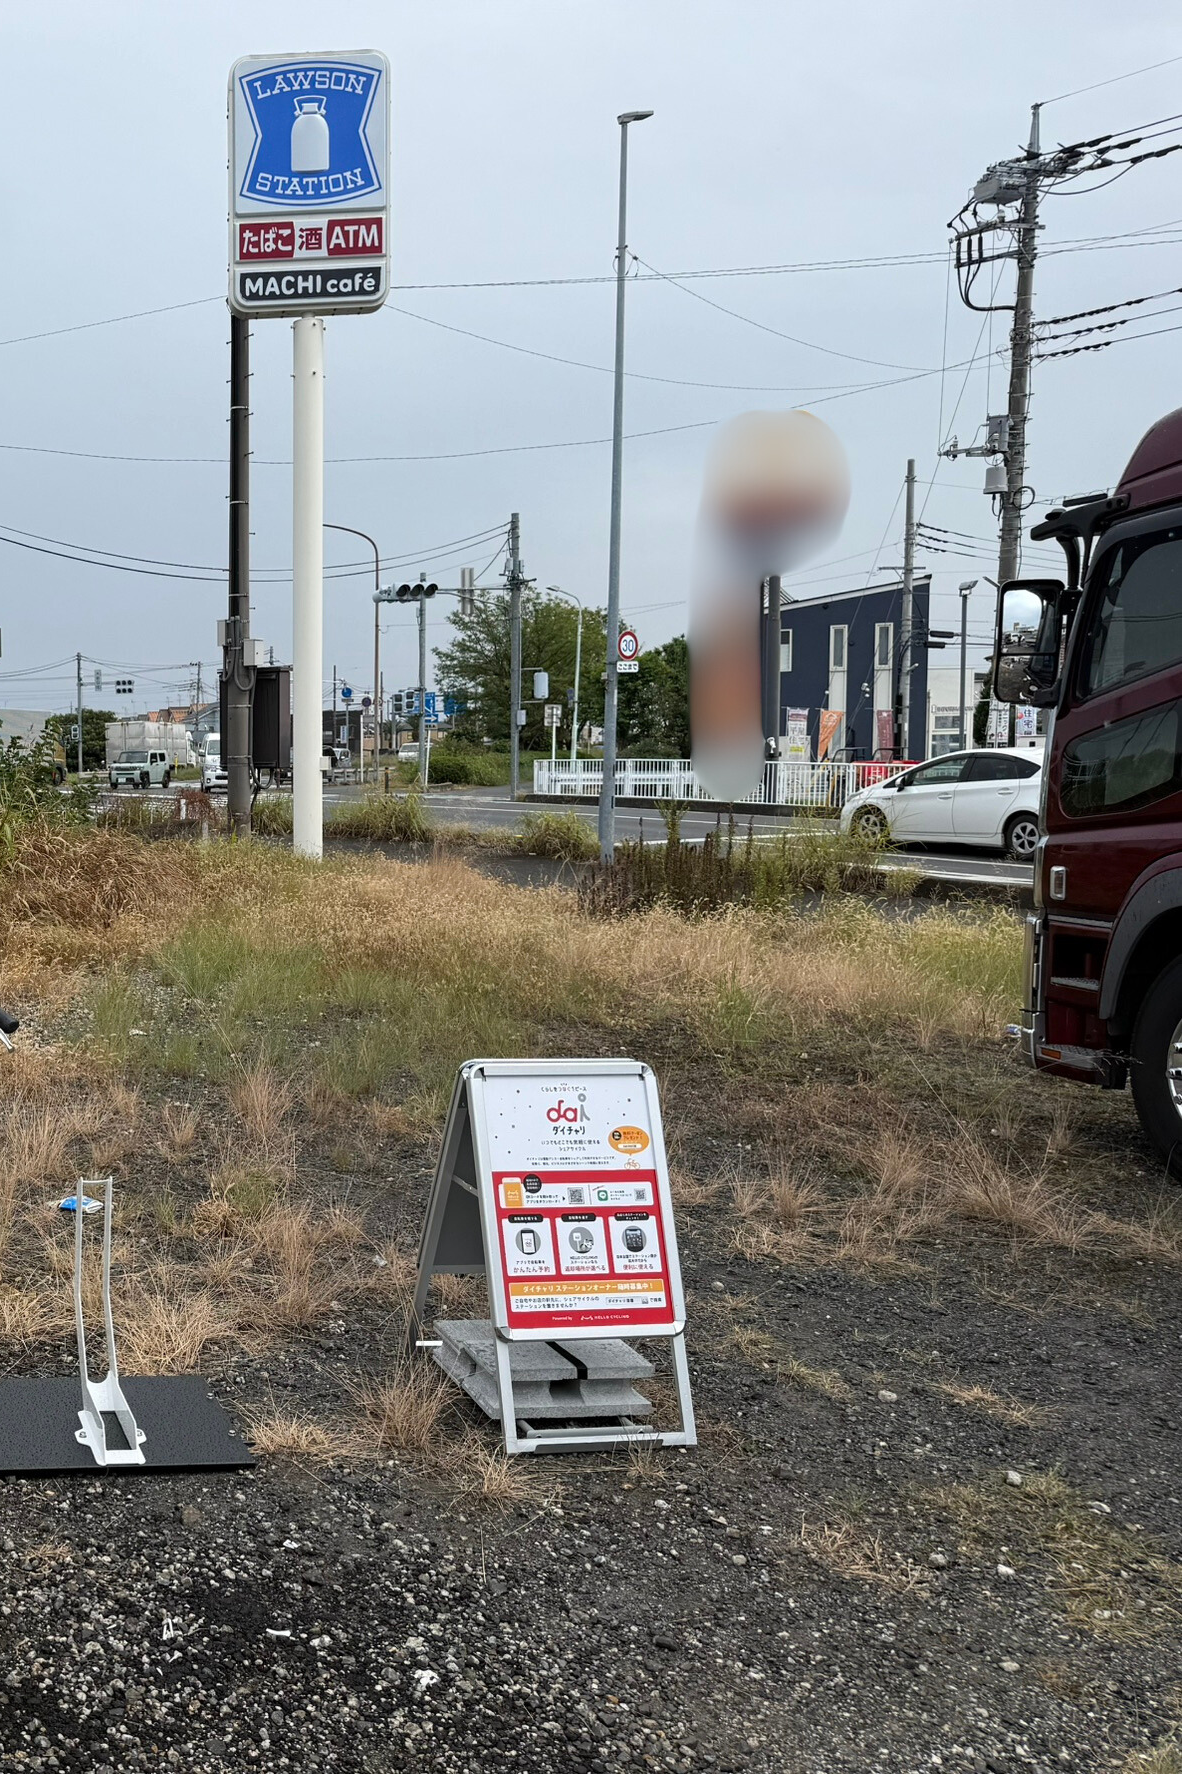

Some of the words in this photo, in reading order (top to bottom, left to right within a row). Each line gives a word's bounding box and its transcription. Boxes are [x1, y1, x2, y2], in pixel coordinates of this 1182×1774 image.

[254, 71, 366, 99] LAWSON
[256, 167, 365, 196] STATION
[242, 226, 293, 254] たばこ
[298, 227, 323, 251] 酒
[329, 223, 379, 249] ATM
[245, 274, 322, 297] MACHI
[326, 273, 376, 294] café
[622, 639, 634, 652] 30
[552, 1126, 586, 1135] ダイチャリ
[513, 1265, 550, 1273] かんたん予約
[523, 1285, 554, 1293] ダイチャリ
